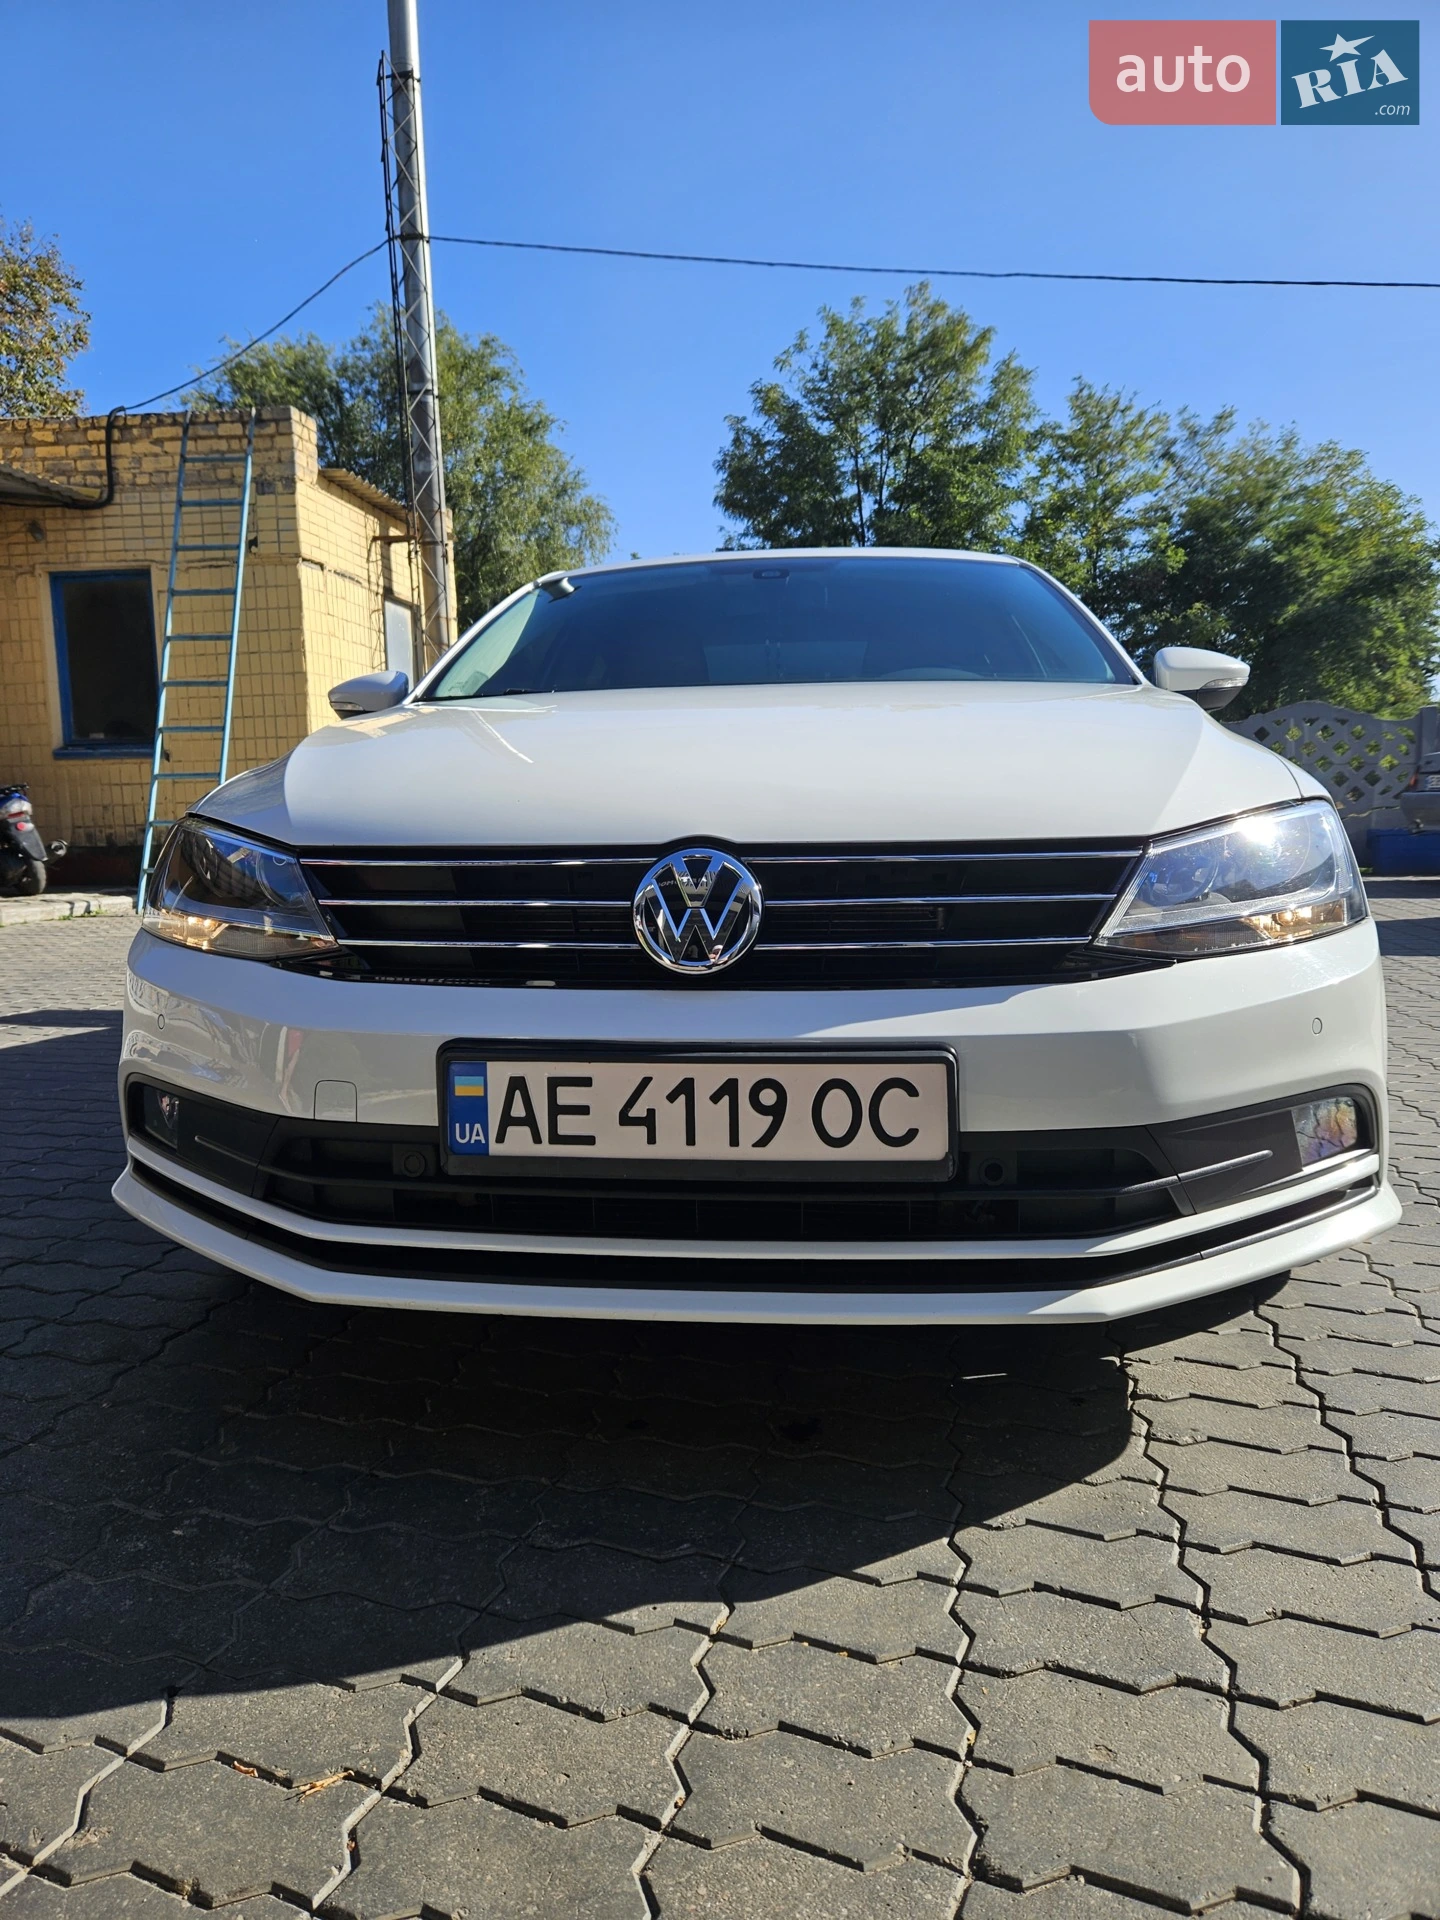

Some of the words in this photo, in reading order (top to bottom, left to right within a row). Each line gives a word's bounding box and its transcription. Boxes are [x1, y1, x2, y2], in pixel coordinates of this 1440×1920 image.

[455, 1122, 486, 1145] UA
[495, 1075, 597, 1146] AE
[618, 1076, 788, 1149] 4119
[810, 1076, 920, 1149] OC
